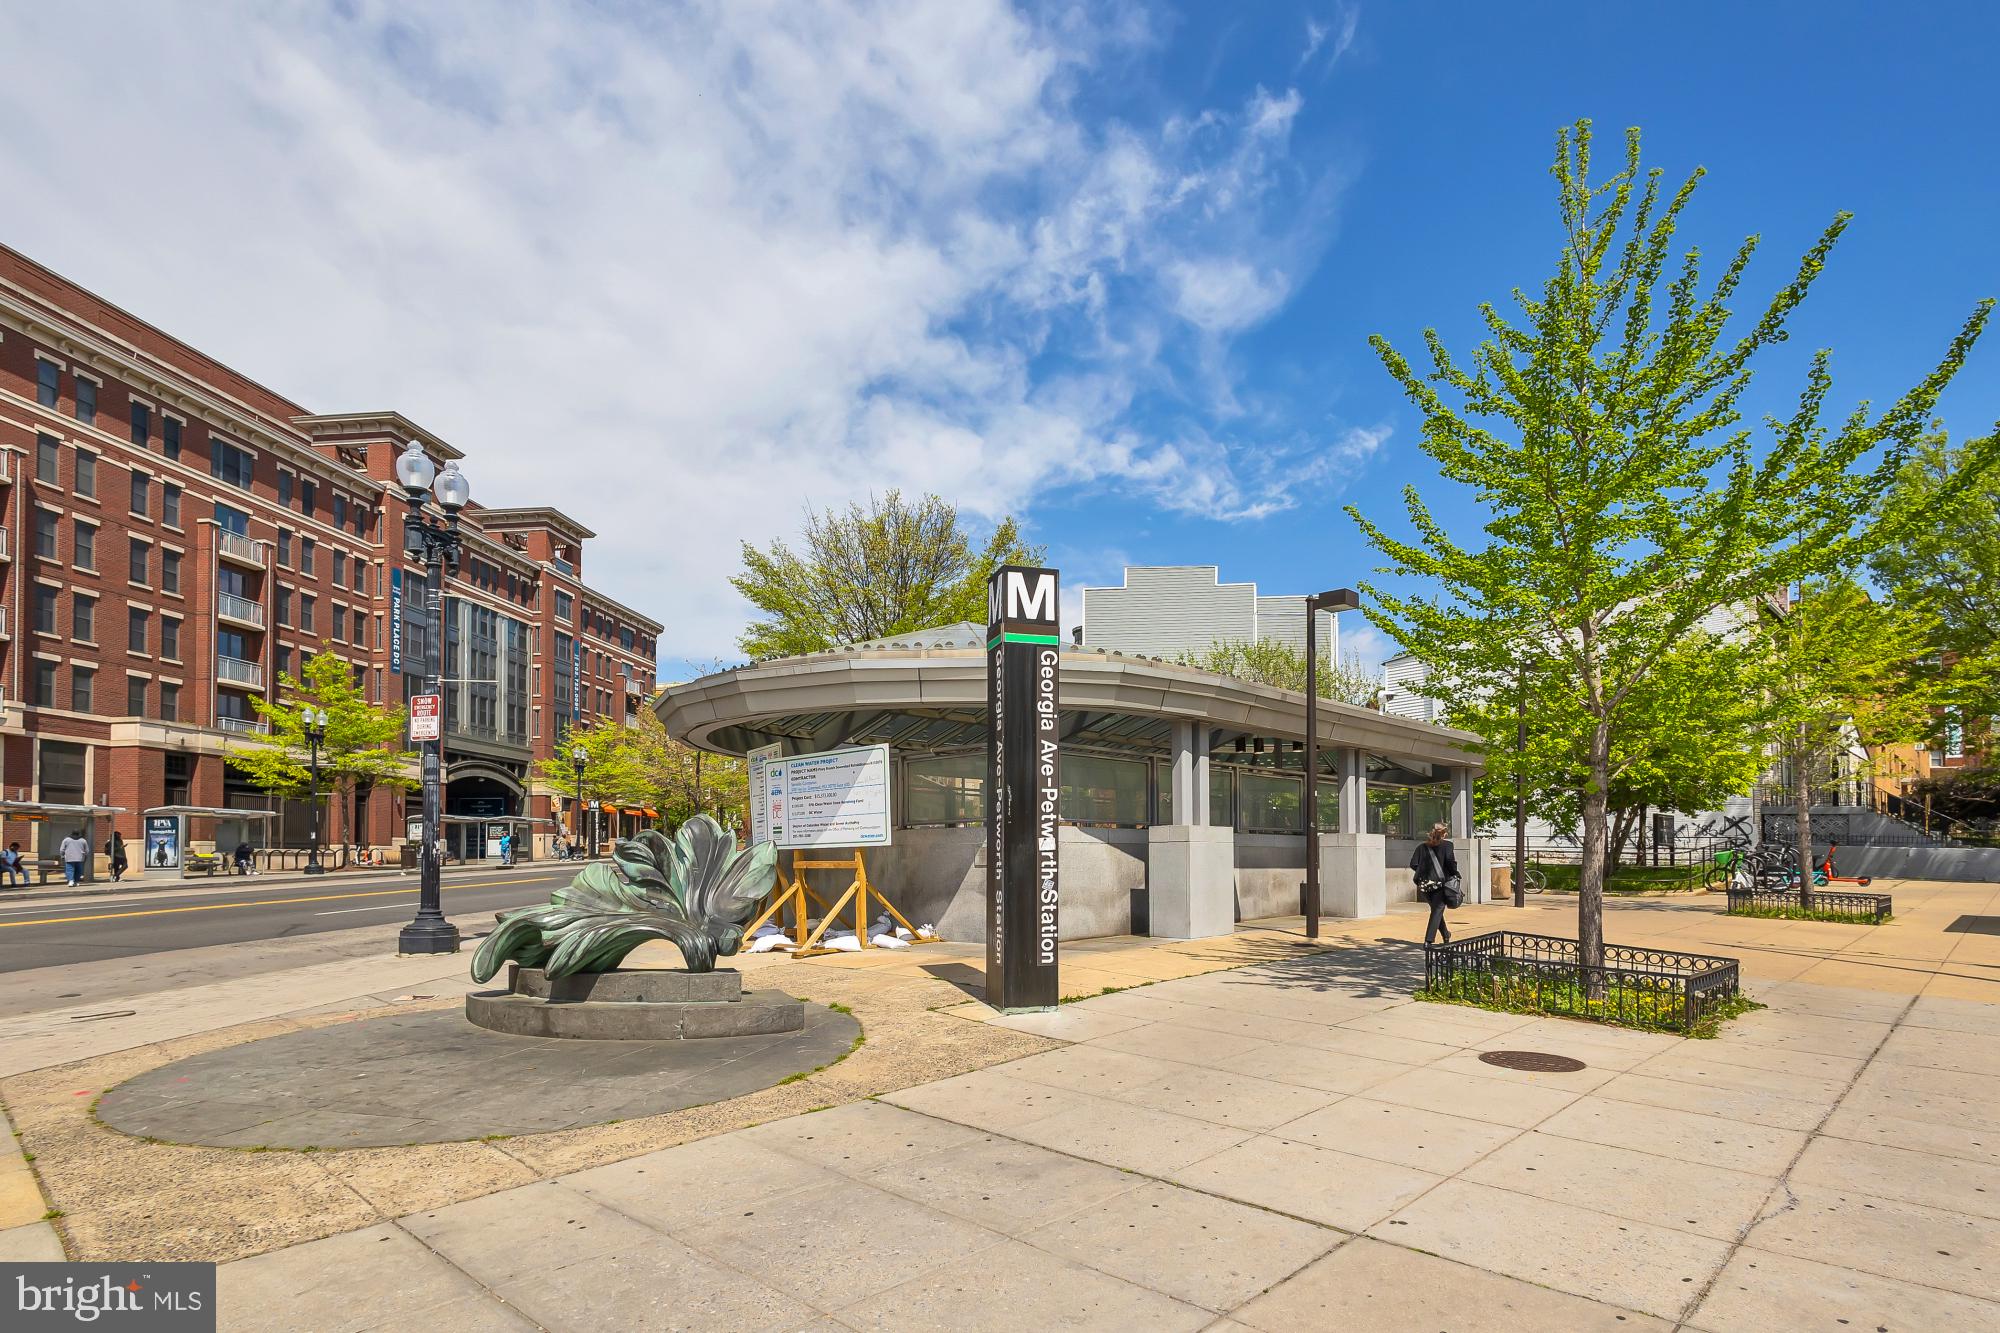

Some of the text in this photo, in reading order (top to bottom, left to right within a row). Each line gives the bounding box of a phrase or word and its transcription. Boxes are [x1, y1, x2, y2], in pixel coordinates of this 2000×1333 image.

[988, 573, 1003, 627] M
[1007, 571, 1055, 621] M
[393, 597, 401, 665] PARK PLACE DC
[995, 650, 1004, 731] Georgia
[1037, 650, 1058, 964] Georgia Ave-Petwrth Station
